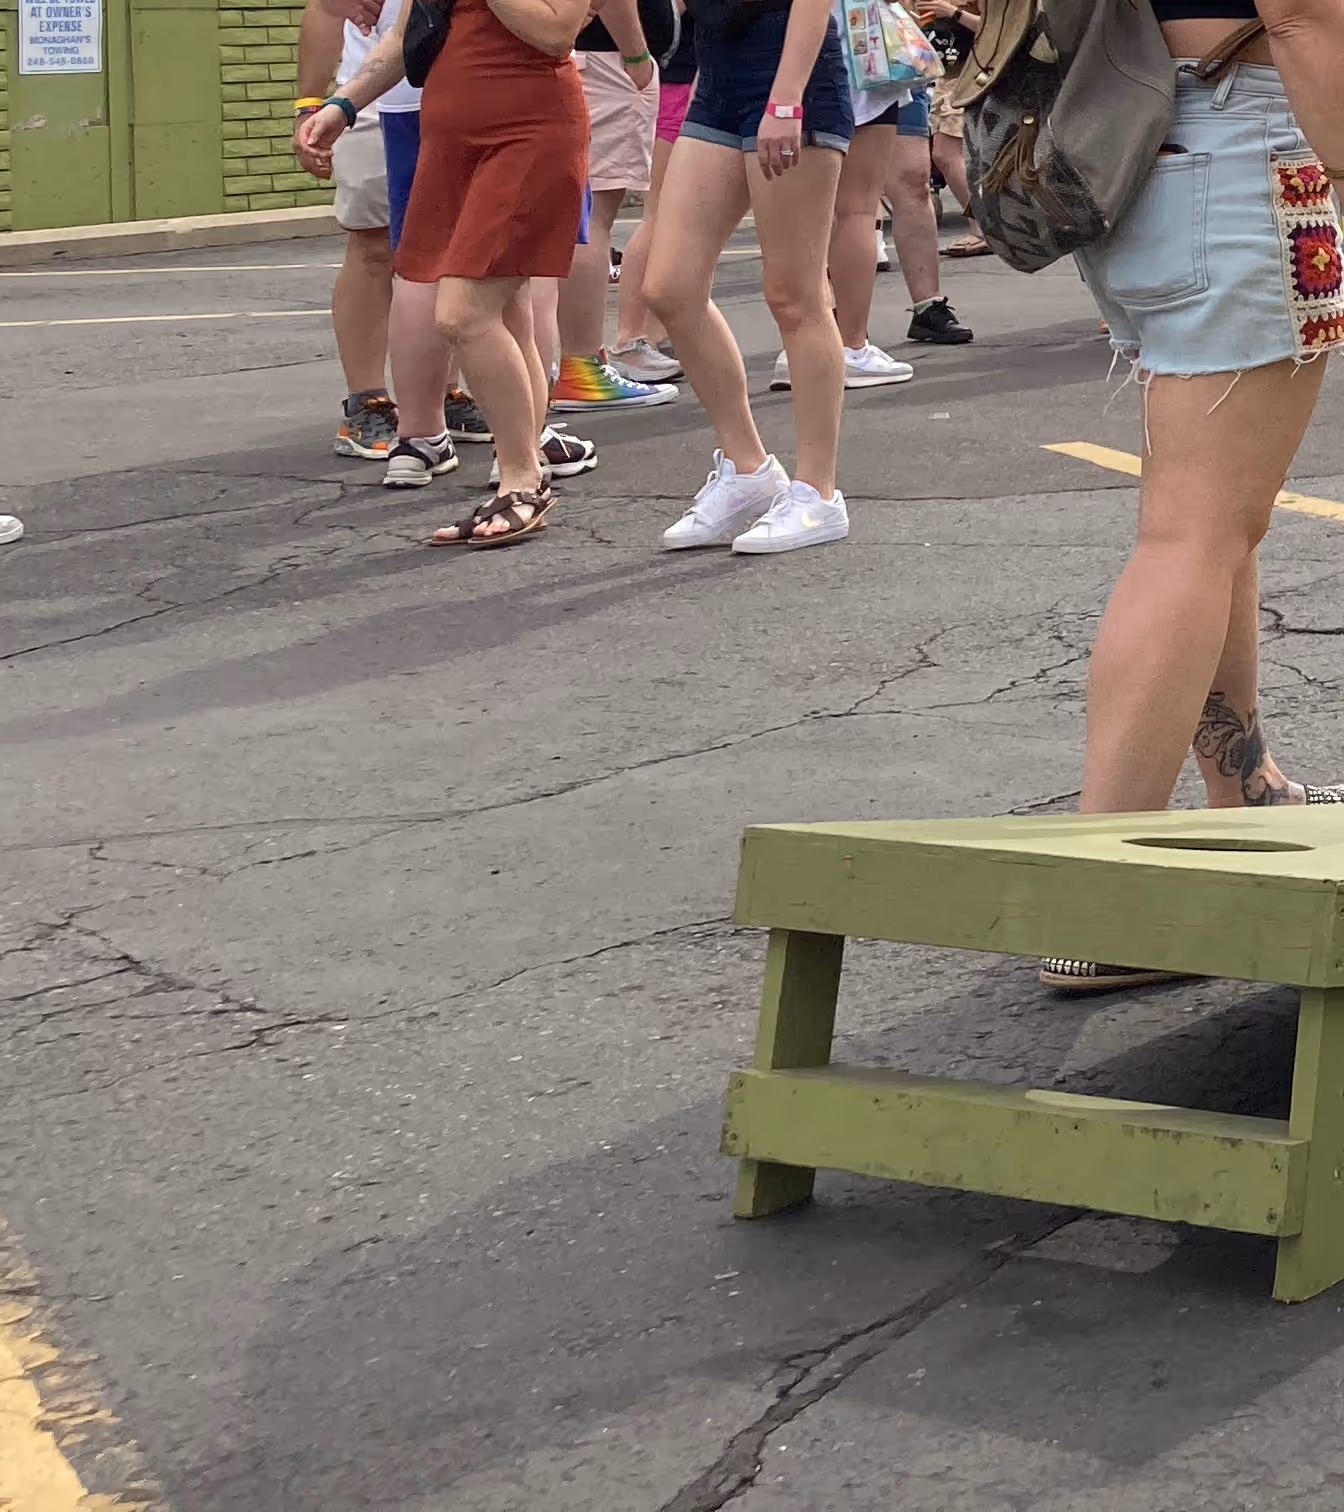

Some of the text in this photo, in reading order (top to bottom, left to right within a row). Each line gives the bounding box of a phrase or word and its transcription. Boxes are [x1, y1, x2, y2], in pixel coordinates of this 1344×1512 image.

[30, 6, 92, 18] AT OWNER'S
[39, 20, 83, 33] EXPENSE
[43, 46, 80, 55] TOWING
